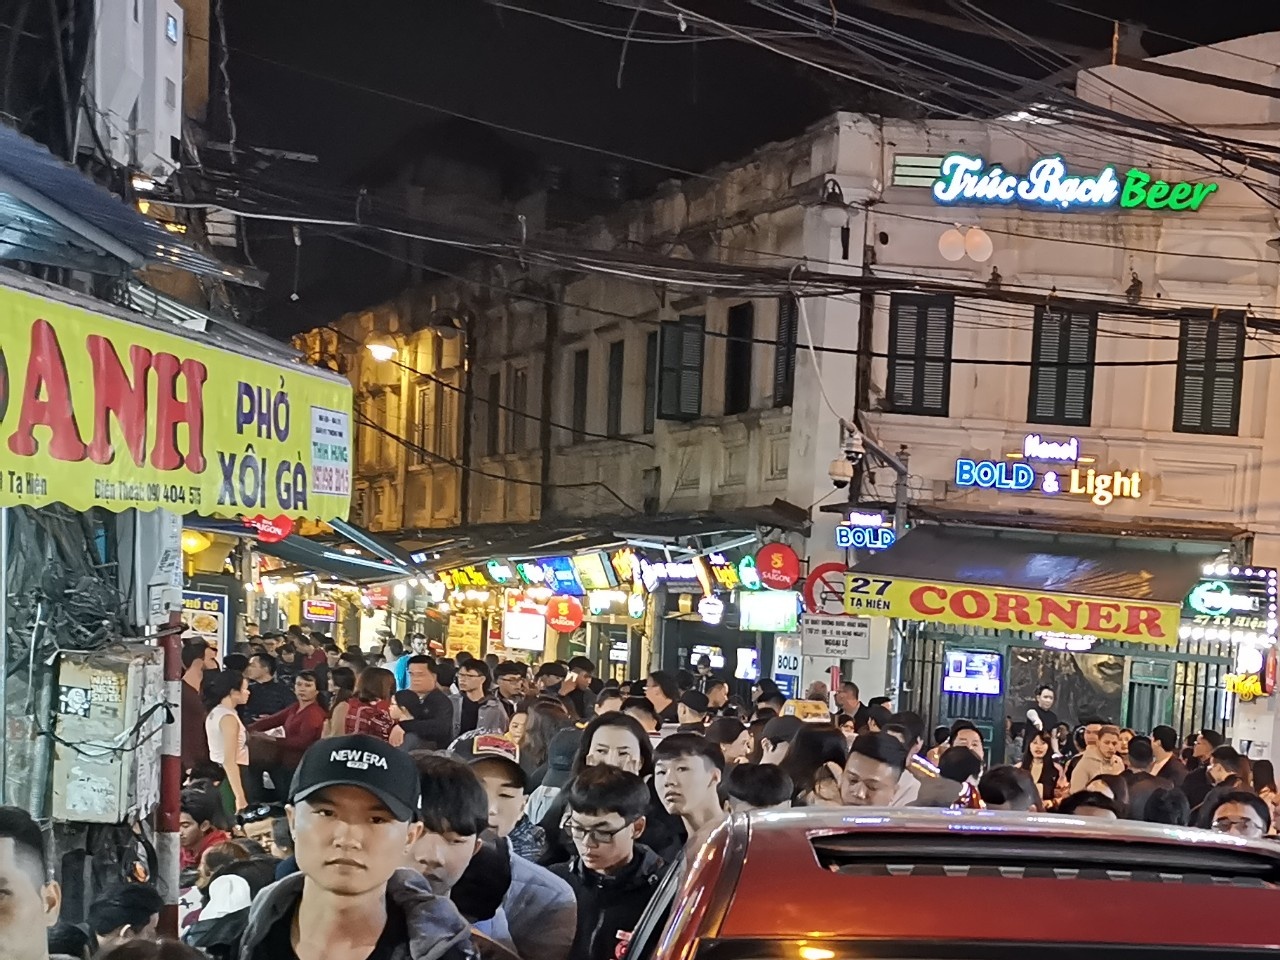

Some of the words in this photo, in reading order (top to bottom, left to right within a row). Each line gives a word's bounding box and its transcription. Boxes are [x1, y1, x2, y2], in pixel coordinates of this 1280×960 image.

[934, 155, 1015, 201] Trúc
[1017, 157, 1119, 208] Bạch
[1120, 168, 1218, 211] Beer
[0, 318, 208, 474] ANH
[8, 470, 23, 499] Tạ
[217, 443, 266, 508] XÔI
[275, 451, 308, 511] GÀ
[956, 458, 1035, 490] BOLD
[1043, 471, 1060, 493] &
[1070, 468, 1142, 506] Light
[163, 484, 186, 503] 404
[836, 526, 896, 549] BOLD
[850, 577, 893, 597] 27
[850, 597, 862, 608] TẠ
[865, 599, 891, 611] HIỆN
[909, 586, 1167, 639] CORNER
[777, 655, 800, 671] BOLD
[330, 750, 362, 763] NEW
[362, 752, 388, 770] ERA
